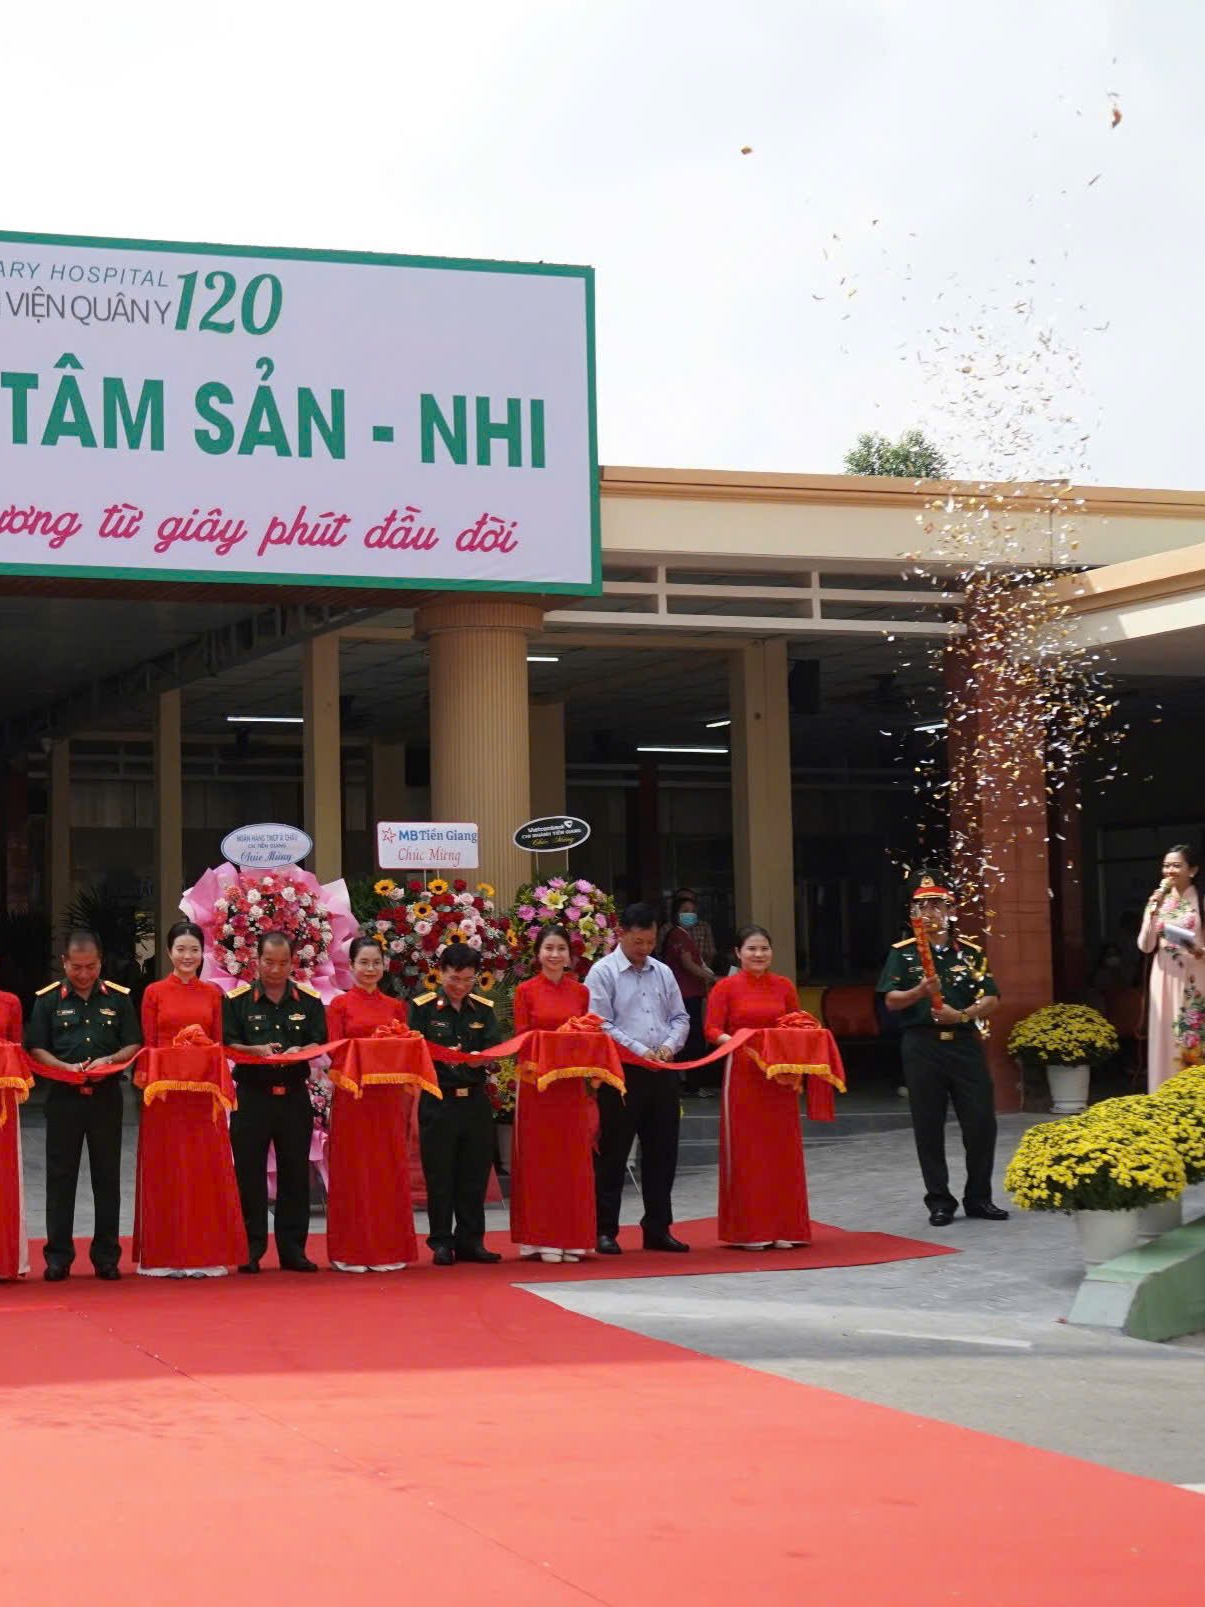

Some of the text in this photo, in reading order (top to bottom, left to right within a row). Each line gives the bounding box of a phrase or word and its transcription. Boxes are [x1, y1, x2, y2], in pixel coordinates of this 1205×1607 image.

[50, 264, 169, 287] HOSPITAL
[5, 285, 66, 324] VIỆN
[70, 292, 150, 326] QUÂN
[153, 300, 172, 325] Y
[174, 270, 284, 336] 120
[0, 352, 166, 452] TÂM
[194, 356, 346, 460] SẢN
[419, 392, 546, 469] NHI
[98, 503, 144, 539] từ
[153, 508, 248, 555] giây
[256, 505, 349, 557] phút
[363, 506, 440, 552] đầu
[455, 512, 519, 554] đời
[397, 846, 425, 861] Chúc
[398, 827, 478, 844] MB Tiền Giang
